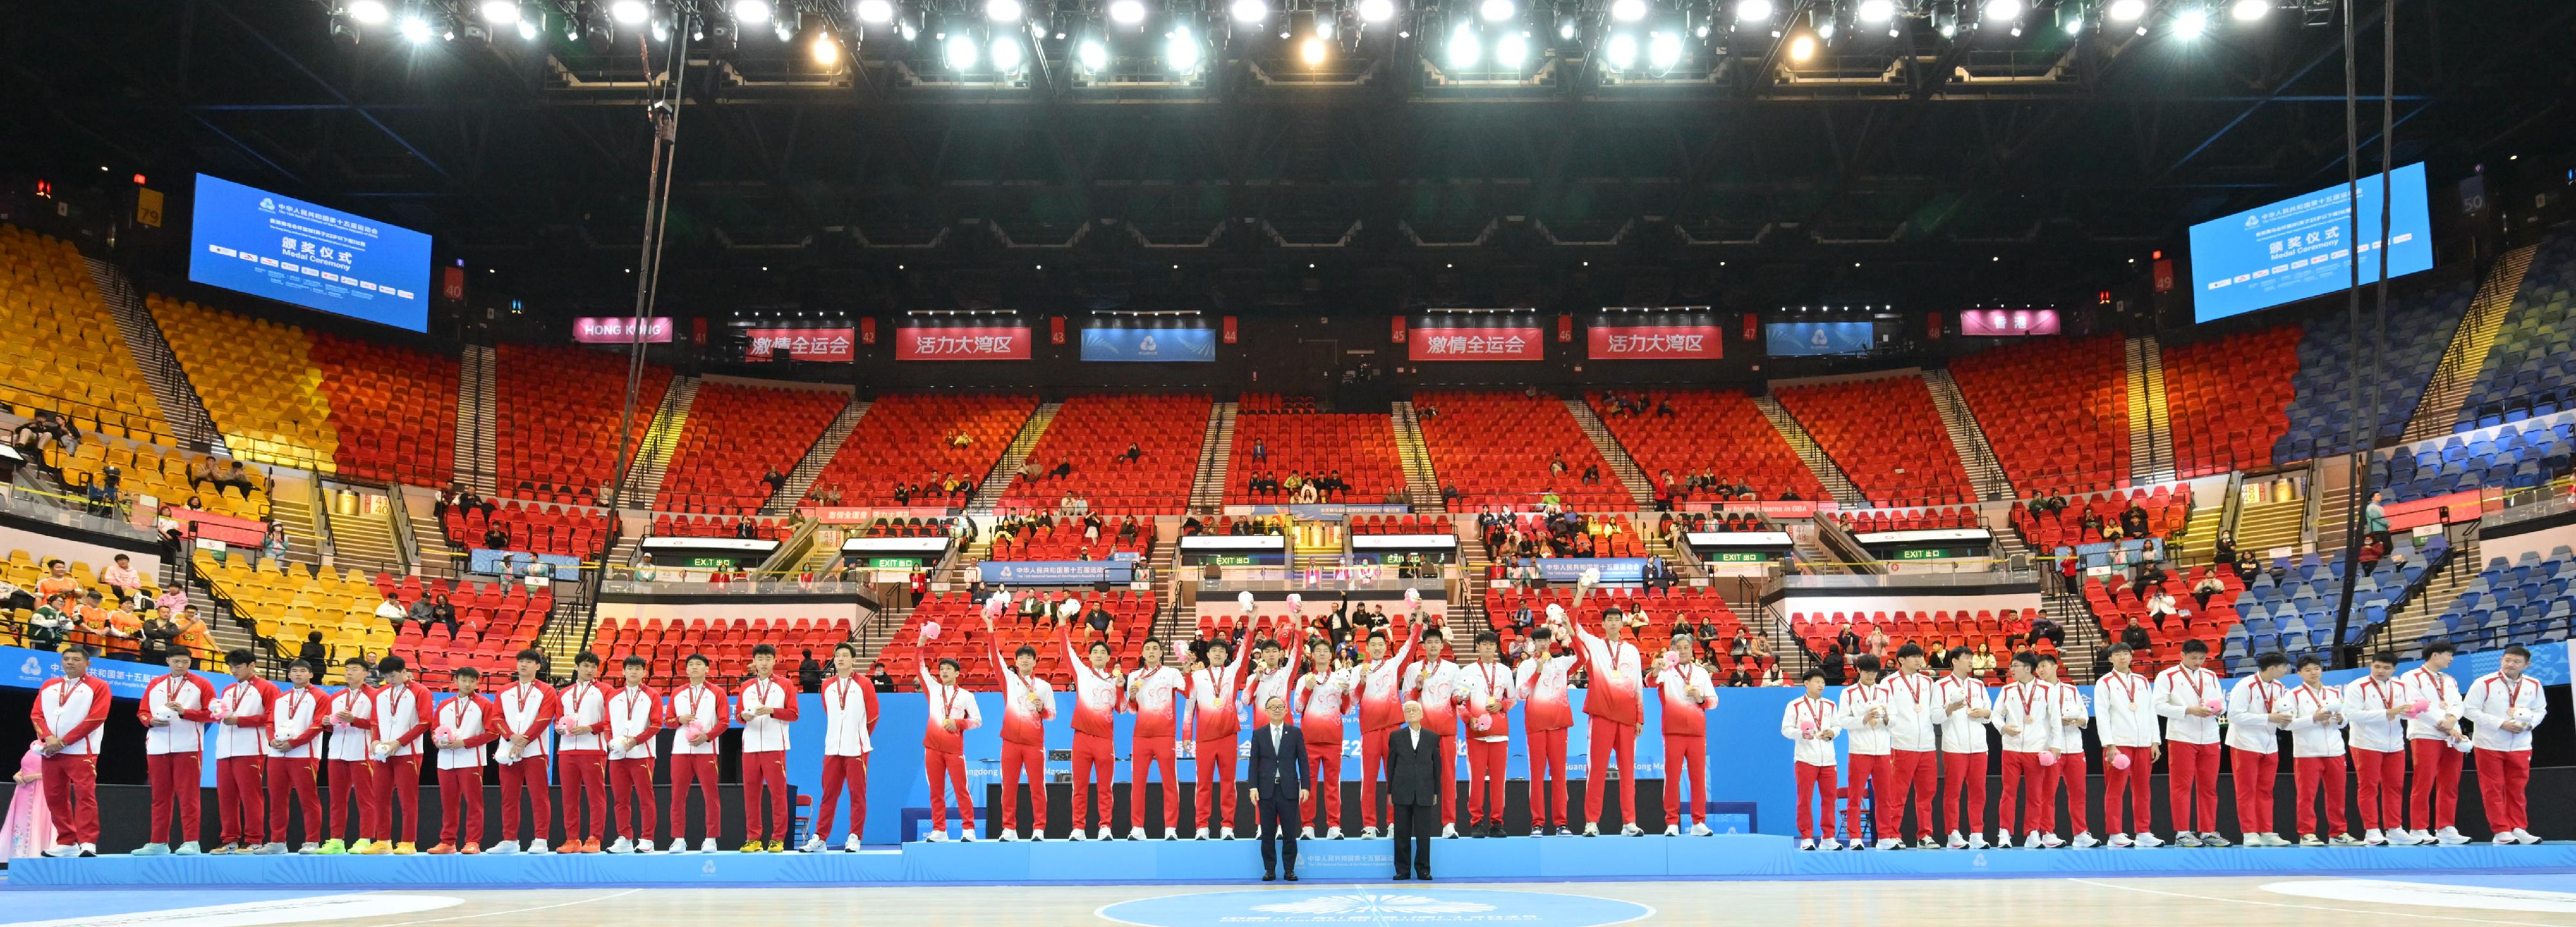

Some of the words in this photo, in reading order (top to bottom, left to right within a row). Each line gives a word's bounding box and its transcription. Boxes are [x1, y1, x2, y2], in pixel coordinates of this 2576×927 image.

[2262, 187, 2362, 220] 中华人民共和国第十五届运会
[2464, 196, 2483, 212] 50
[140, 207, 159, 224] 79
[2269, 225, 2339, 254] 颁奖仪式
[282, 236, 353, 265] 颁奖仪式
[2271, 249, 2295, 261] Medal
[2298, 239, 2339, 254] Ceremony
[282, 249, 308, 260] Medal
[310, 256, 351, 271] Ceremony
[2157, 277, 2172, 289] 49
[446, 285, 461, 298] 40
[1994, 316, 2027, 329] 香港
[585, 325, 621, 335] HONG
[1225, 330, 1236, 341] 44
[1393, 330, 1404, 341] 45
[1560, 330, 1571, 340] 46
[1745, 329, 1756, 338] 47
[696, 333, 706, 343] 41
[863, 332, 875, 342] 42
[1053, 332, 1064, 343] 43
[751, 336, 850, 355] 激情全运会
[914, 335, 1013, 354] 活力大湾区
[1427, 335, 1526, 354] 激情全运会
[1607, 334, 1703, 353] 活力大湾区
[2242, 484, 2255, 494] 48
[375, 497, 388, 506] 41
[2243, 493, 2255, 502] 49
[375, 506, 388, 515] 40
[828, 511, 867, 520] 激情全運會
[966, 767, 998, 776] angdong
